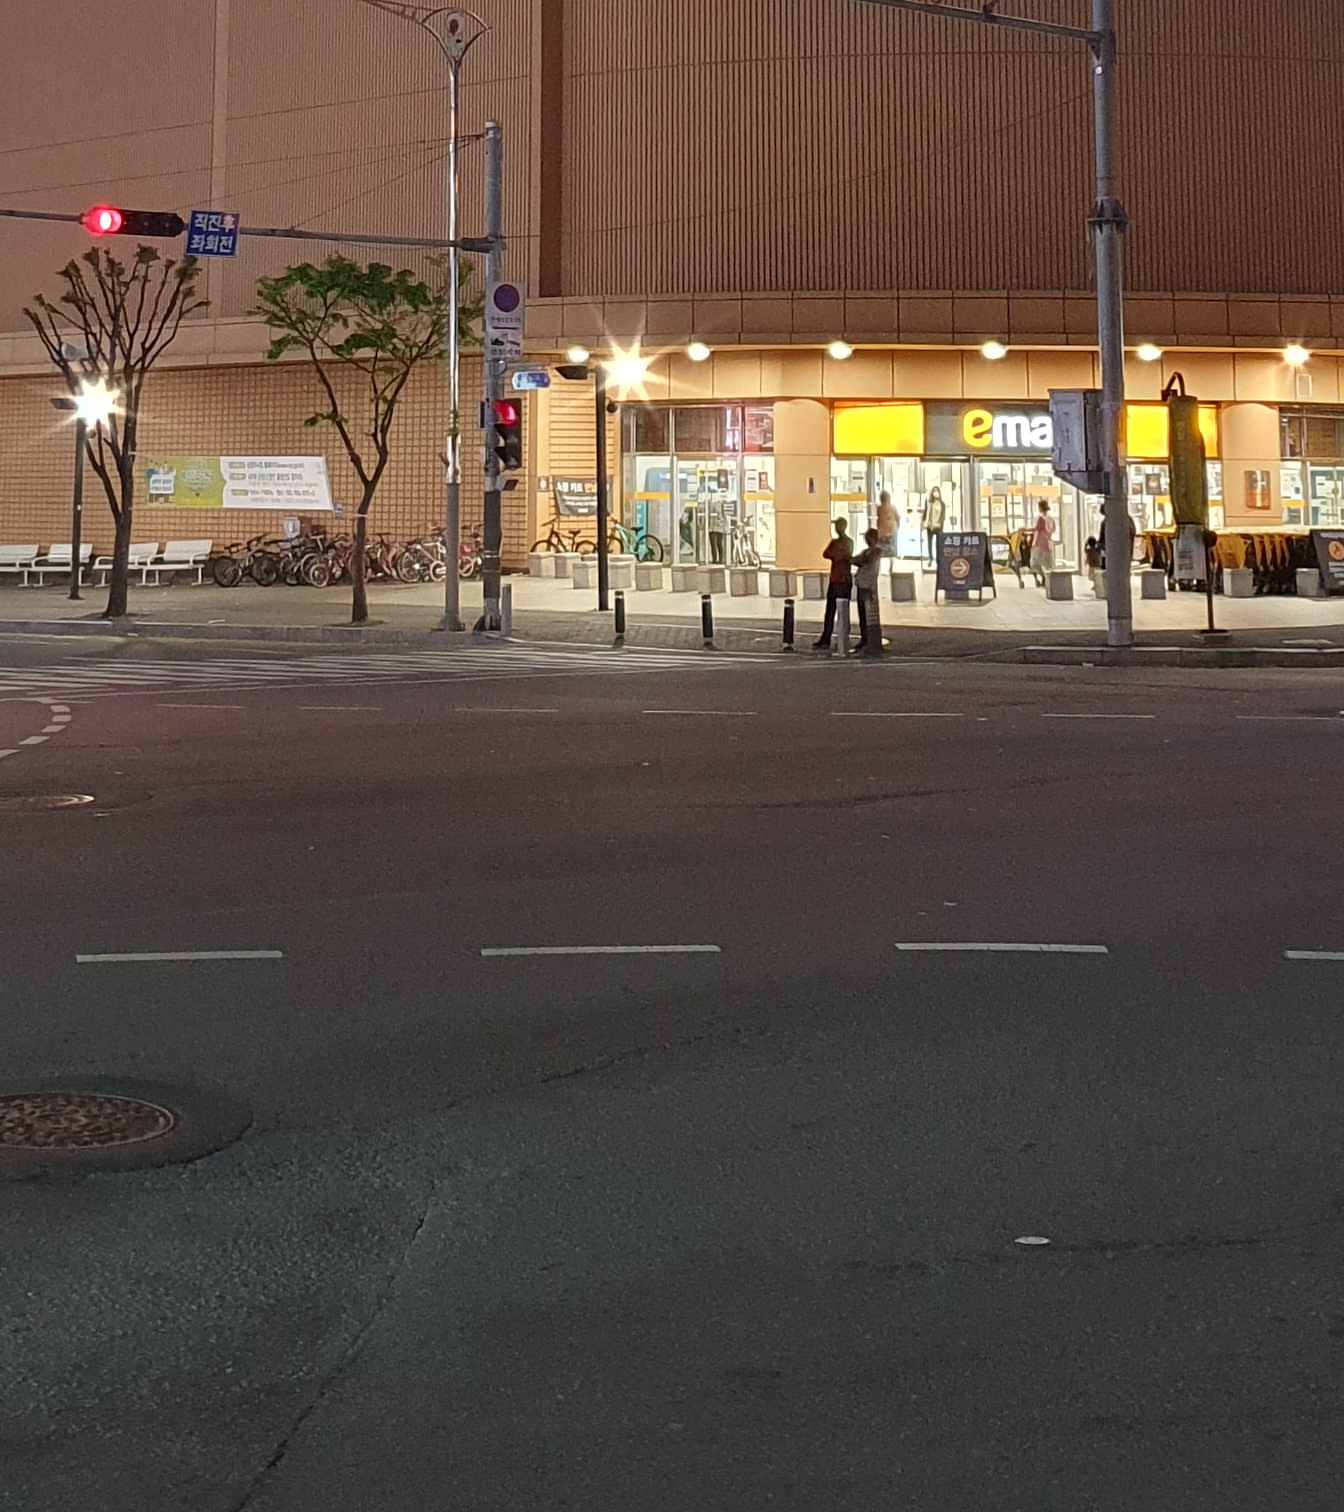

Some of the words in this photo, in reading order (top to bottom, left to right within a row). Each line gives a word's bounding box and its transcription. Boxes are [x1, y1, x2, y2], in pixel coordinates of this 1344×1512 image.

[194, 213, 235, 232] 직진후
[190, 234, 233, 253] 좌회전
[963, 409, 1054, 448] ema
